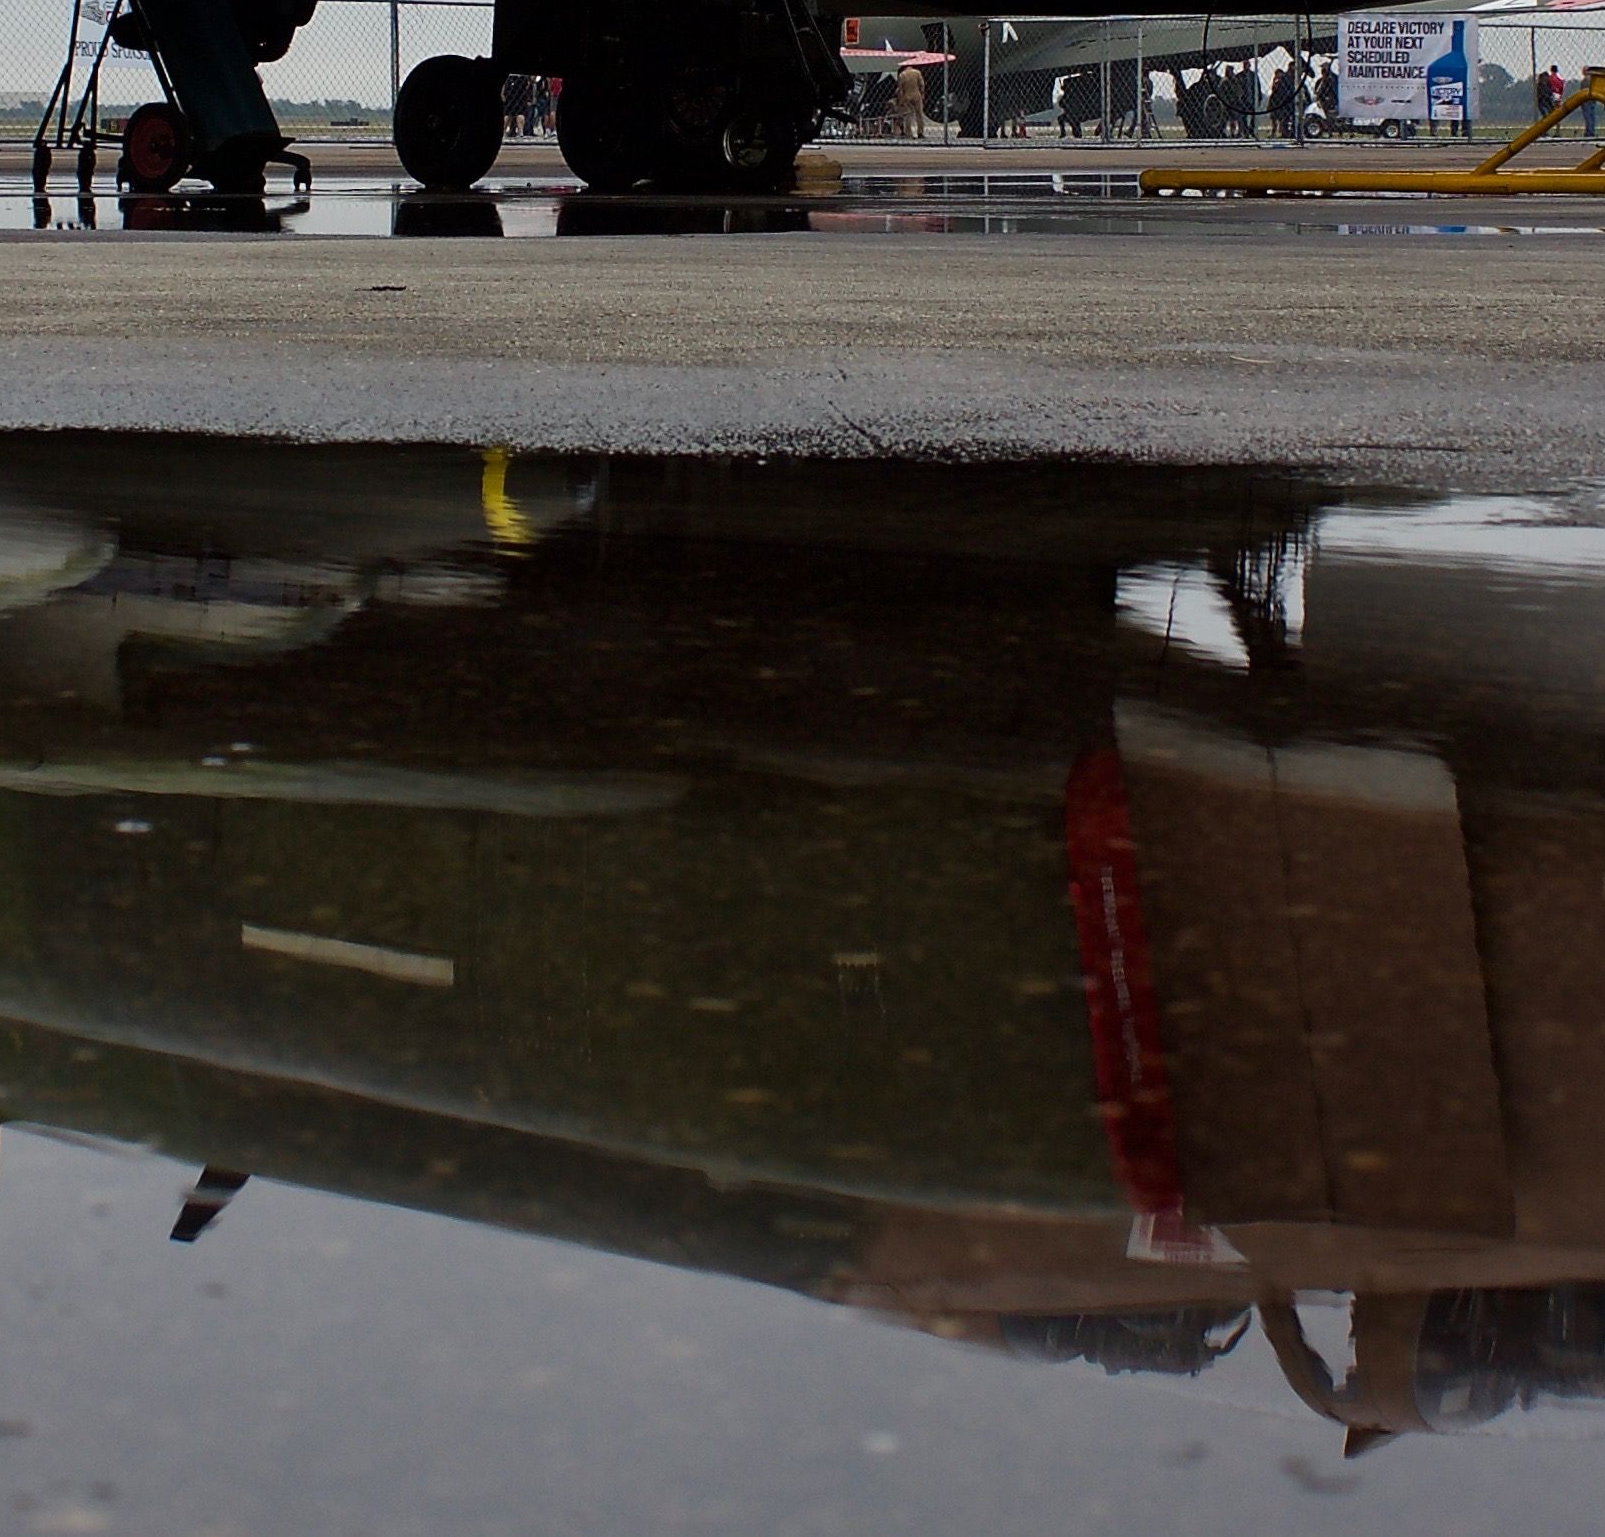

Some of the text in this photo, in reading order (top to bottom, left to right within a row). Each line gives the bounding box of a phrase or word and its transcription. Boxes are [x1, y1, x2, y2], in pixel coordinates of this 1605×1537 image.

[1347, 21, 1445, 35] DECLARE VICTORY
[1347, 36, 1424, 49] AT YOUR NEXT
[1347, 51, 1410, 64] SCHEDULED
